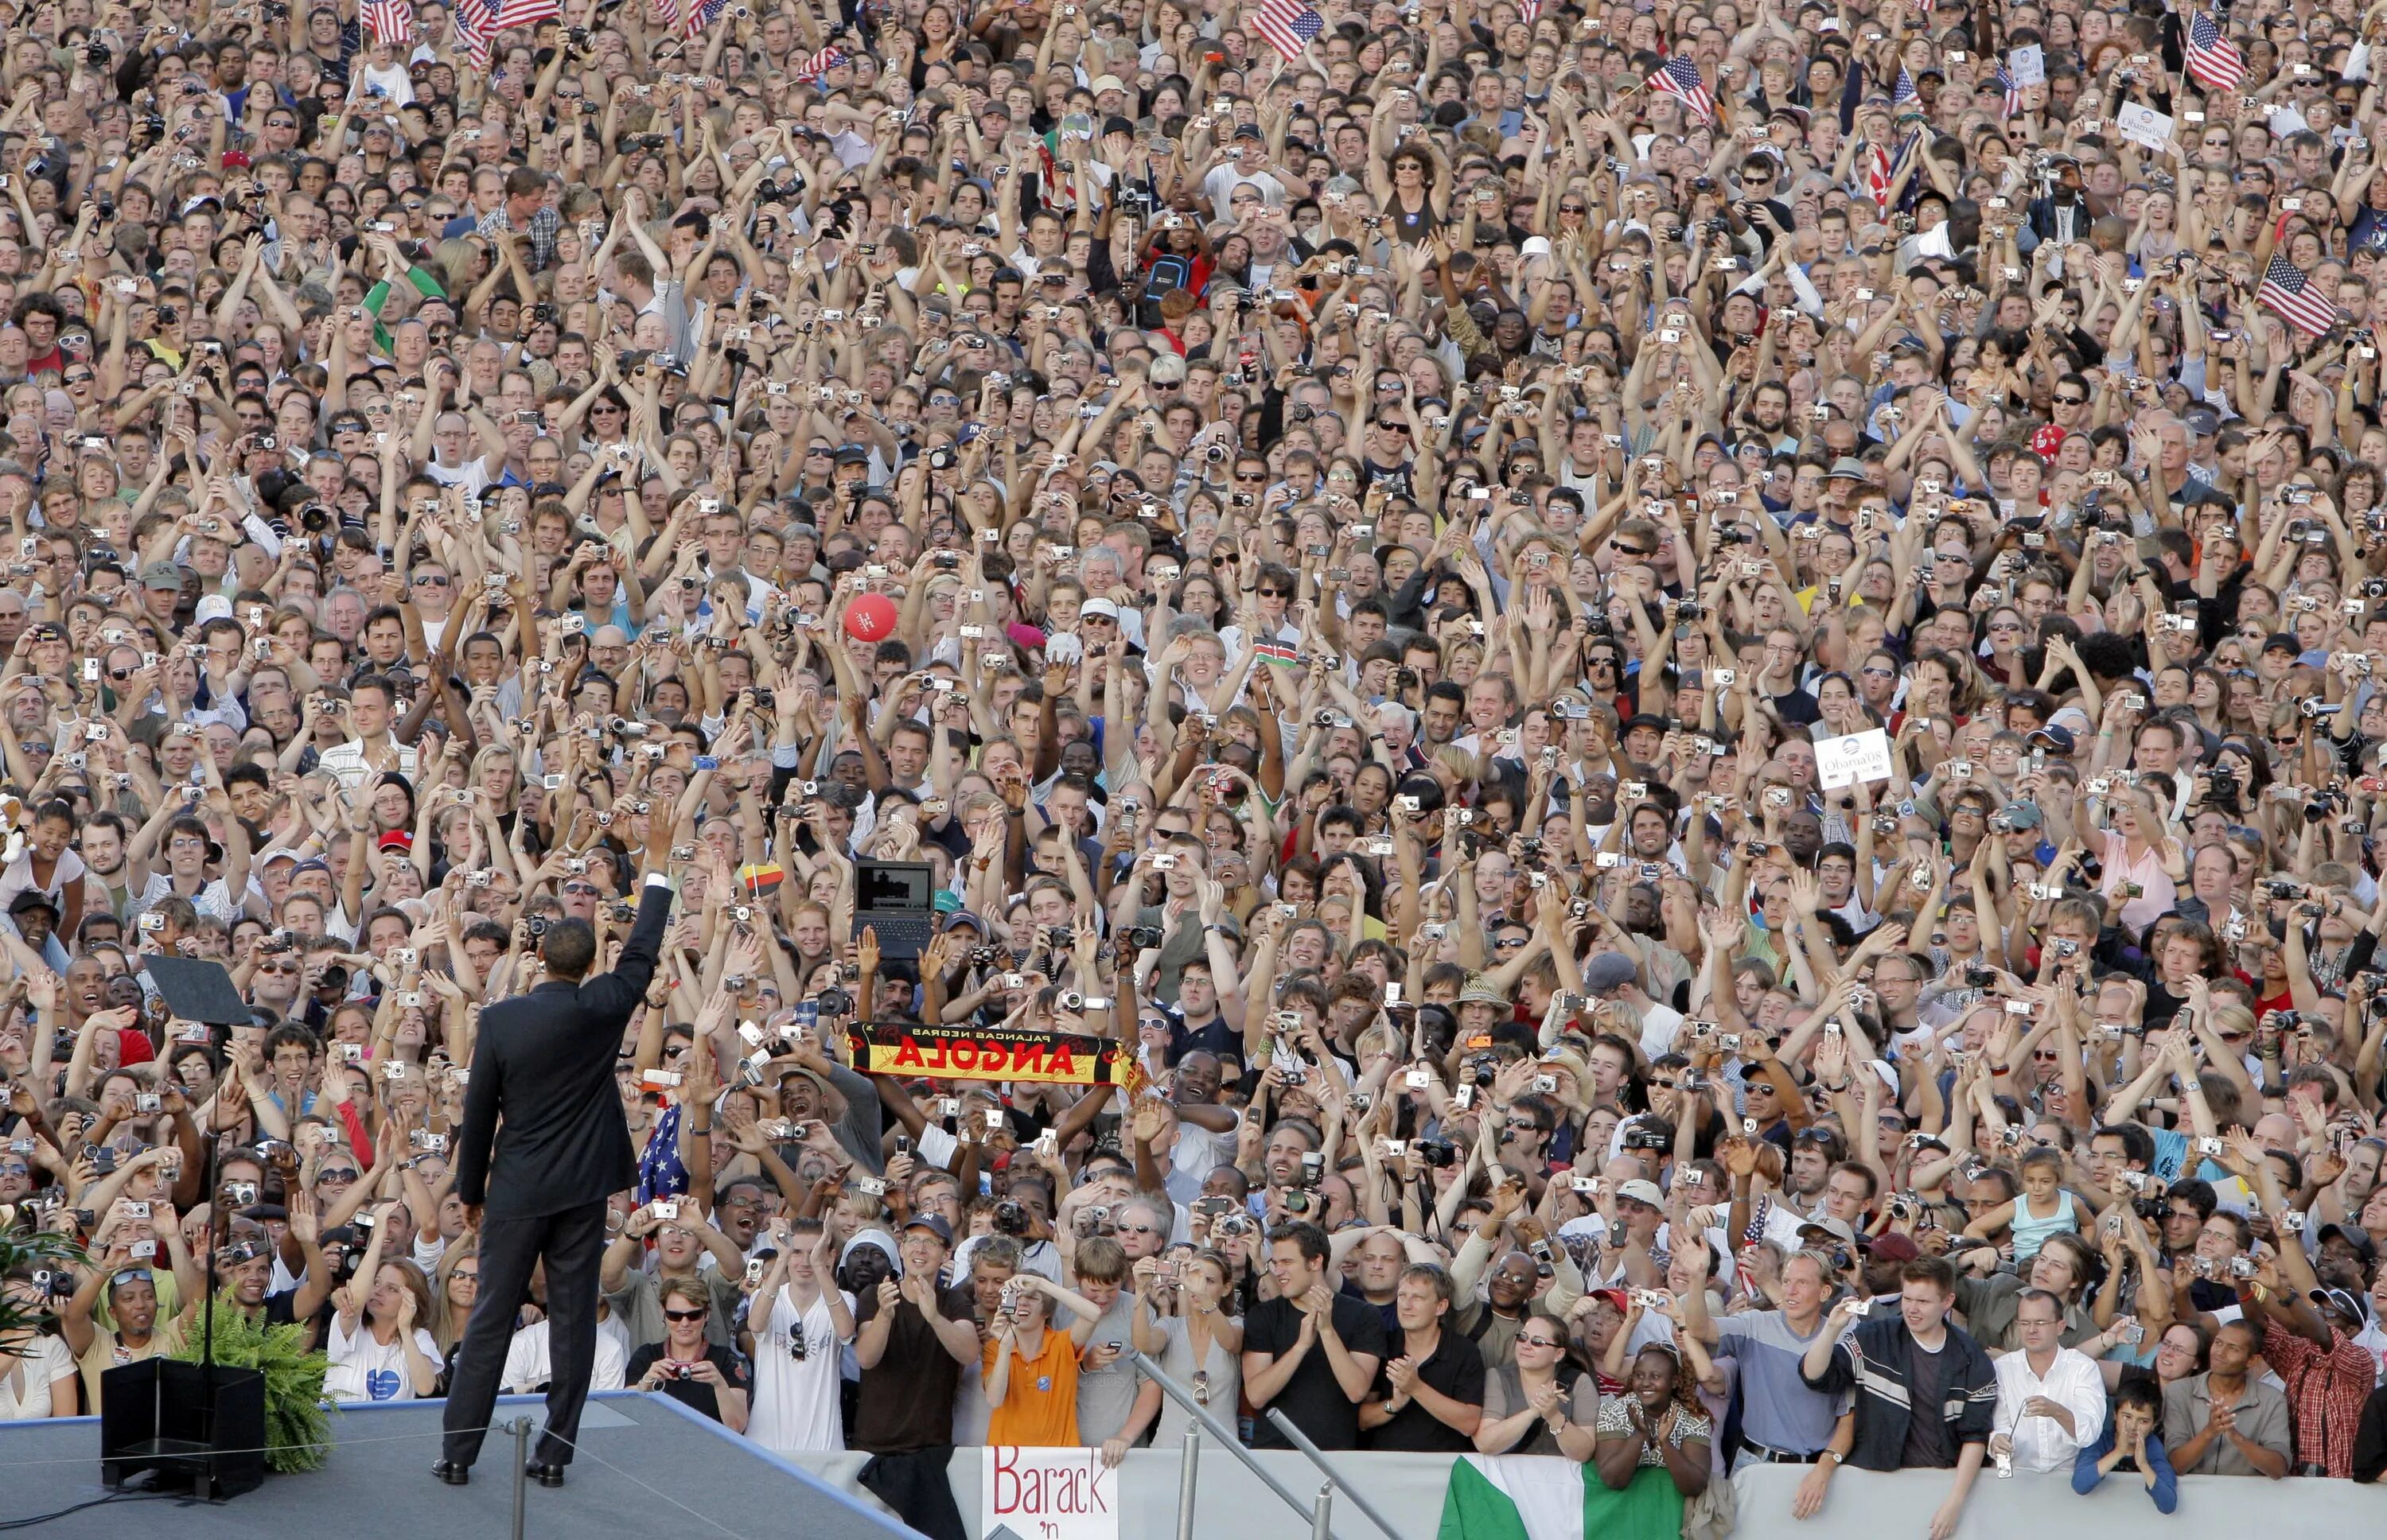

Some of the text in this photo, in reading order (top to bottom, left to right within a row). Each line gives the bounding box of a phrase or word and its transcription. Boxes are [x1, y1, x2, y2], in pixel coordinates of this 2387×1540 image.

[1825, 751, 1883, 772] Obama'08
[994, 1445, 1107, 1515] Barack
[1039, 1520, 1059, 1539] 'n
